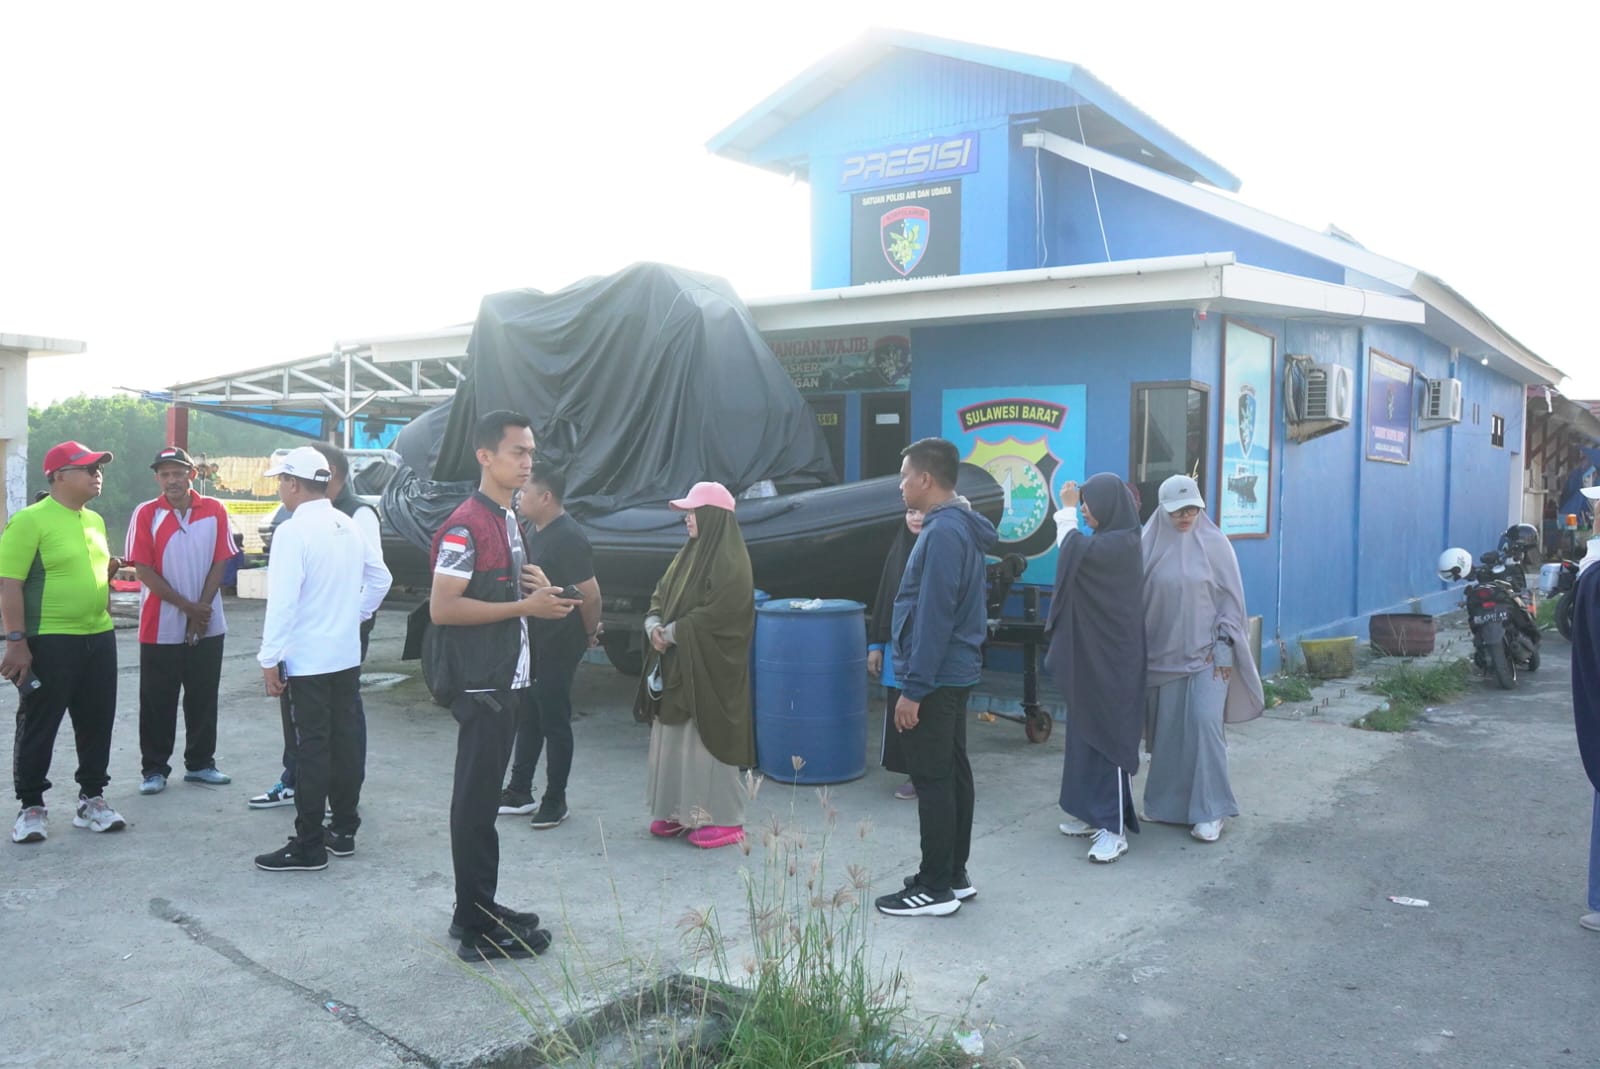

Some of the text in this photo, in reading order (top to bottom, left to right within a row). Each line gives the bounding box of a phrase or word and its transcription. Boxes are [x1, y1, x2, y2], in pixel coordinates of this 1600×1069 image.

[841, 138, 971, 185] PRESISI
[862, 186, 952, 206] SATUAN POLISI AIR DAN UDARA
[965, 405, 1059, 426] SULAWESI BARAT
